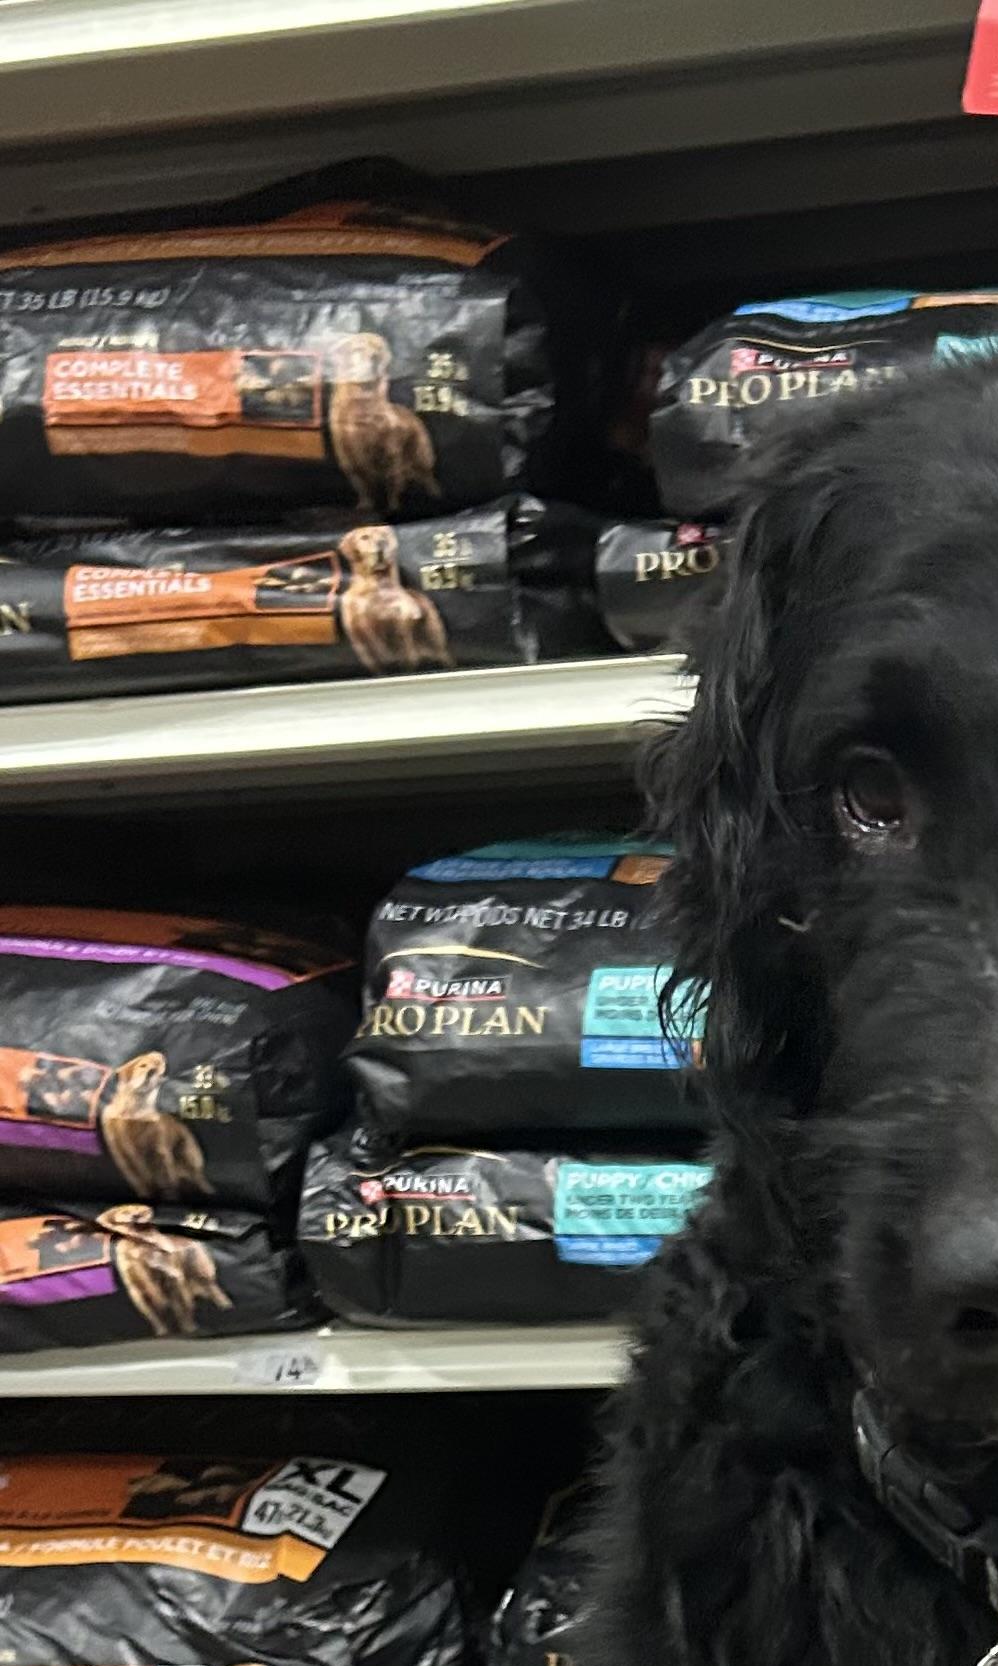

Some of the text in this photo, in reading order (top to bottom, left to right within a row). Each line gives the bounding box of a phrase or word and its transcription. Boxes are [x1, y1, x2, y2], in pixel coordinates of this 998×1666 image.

[17, 290, 45, 311] 35
[48, 289, 79, 309] LB
[53, 360, 184, 380] COMPLETE
[757, 352, 848, 370] PUNA
[52, 381, 198, 400] ESSENTIALS
[73, 577, 212, 603] ESSENTIALS
[379, 902, 425, 921] NET
[524, 907, 568, 930] NET
[568, 910, 597, 931] 34
[598, 909, 629, 929] LB
[415, 979, 502, 997] PURINA
[384, 1175, 470, 1193] PURINA
[567, 1172, 637, 1190] PUPPY
[281, 1460, 363, 1505] XL
